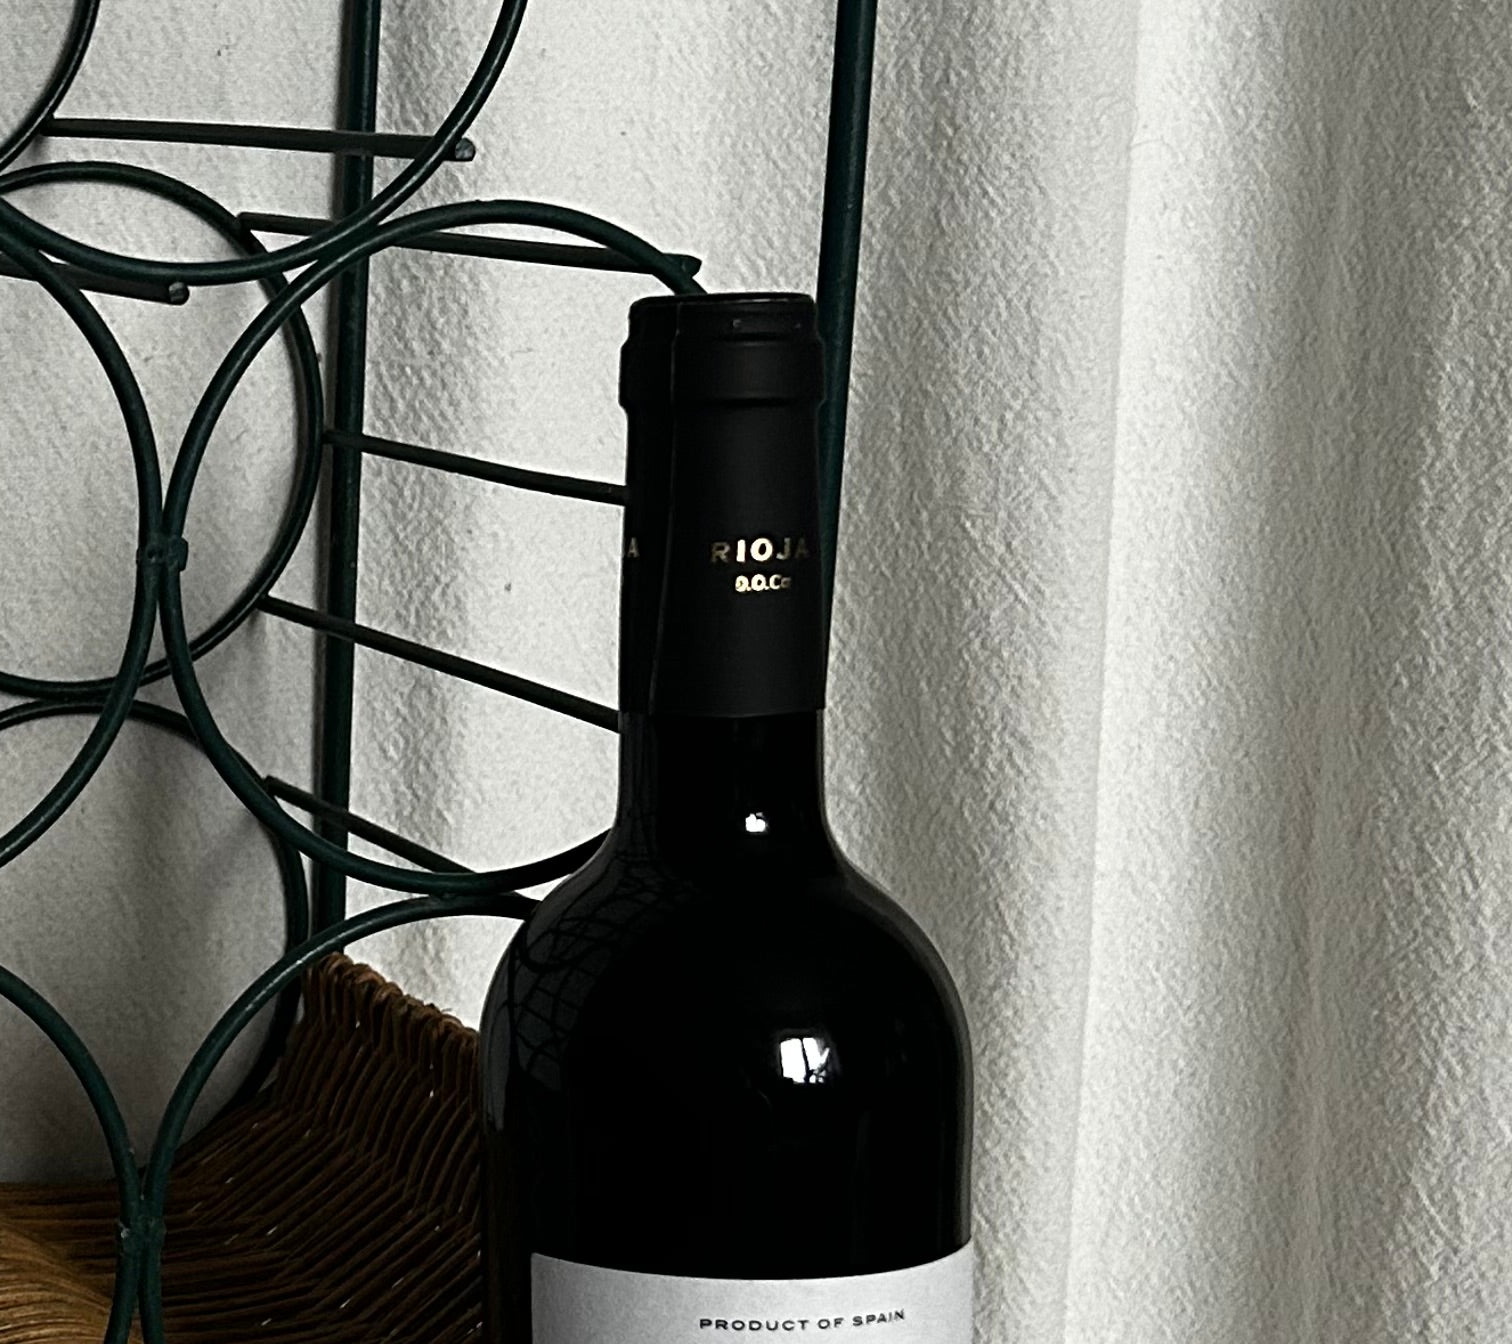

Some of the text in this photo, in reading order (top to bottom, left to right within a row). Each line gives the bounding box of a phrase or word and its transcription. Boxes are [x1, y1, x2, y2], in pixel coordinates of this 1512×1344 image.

[711, 537, 809, 563] RIOJA
[699, 1309, 906, 1332] PRODUCT OF SPAIN
